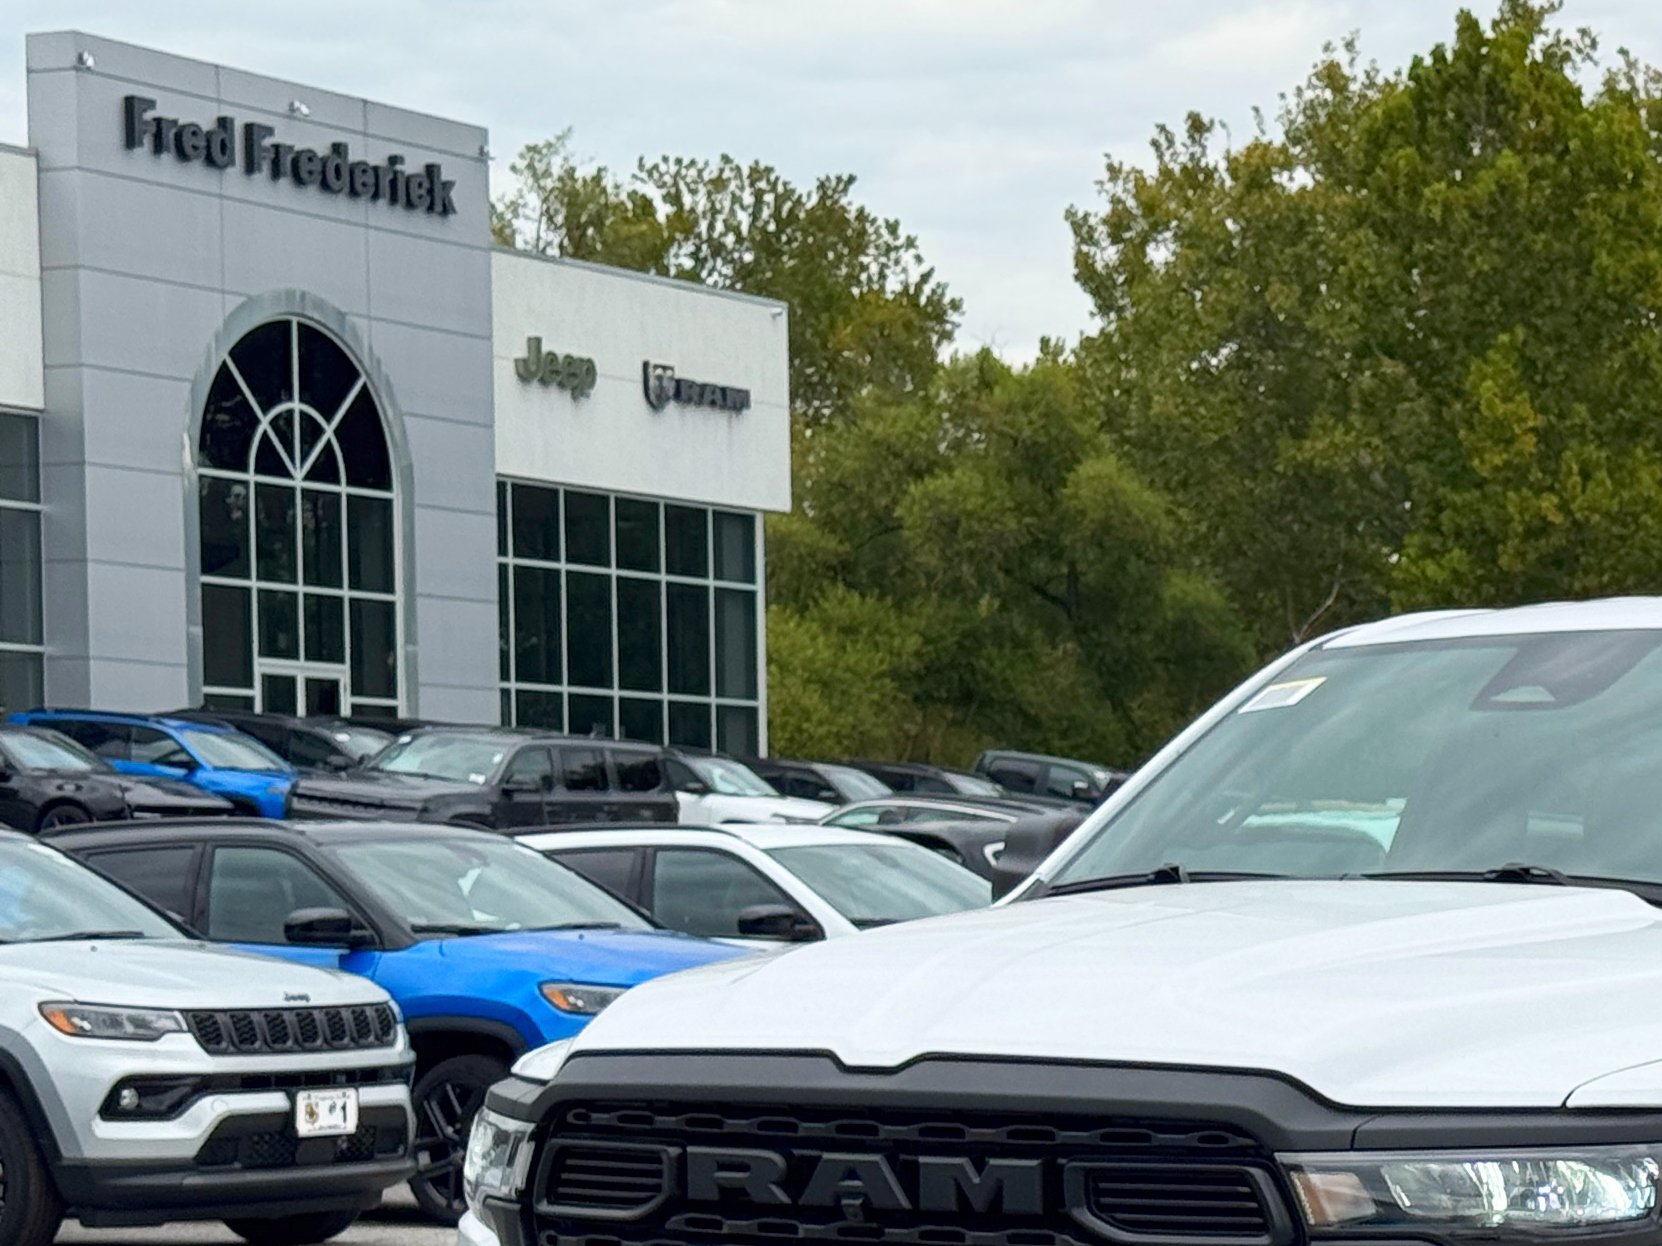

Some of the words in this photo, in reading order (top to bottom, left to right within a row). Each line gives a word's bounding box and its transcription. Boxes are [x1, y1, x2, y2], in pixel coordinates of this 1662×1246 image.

[123, 95, 236, 170] Fred
[243, 121, 458, 217] Frederick
[514, 336, 598, 403] Jeep
[686, 1145, 1044, 1216] RAM
